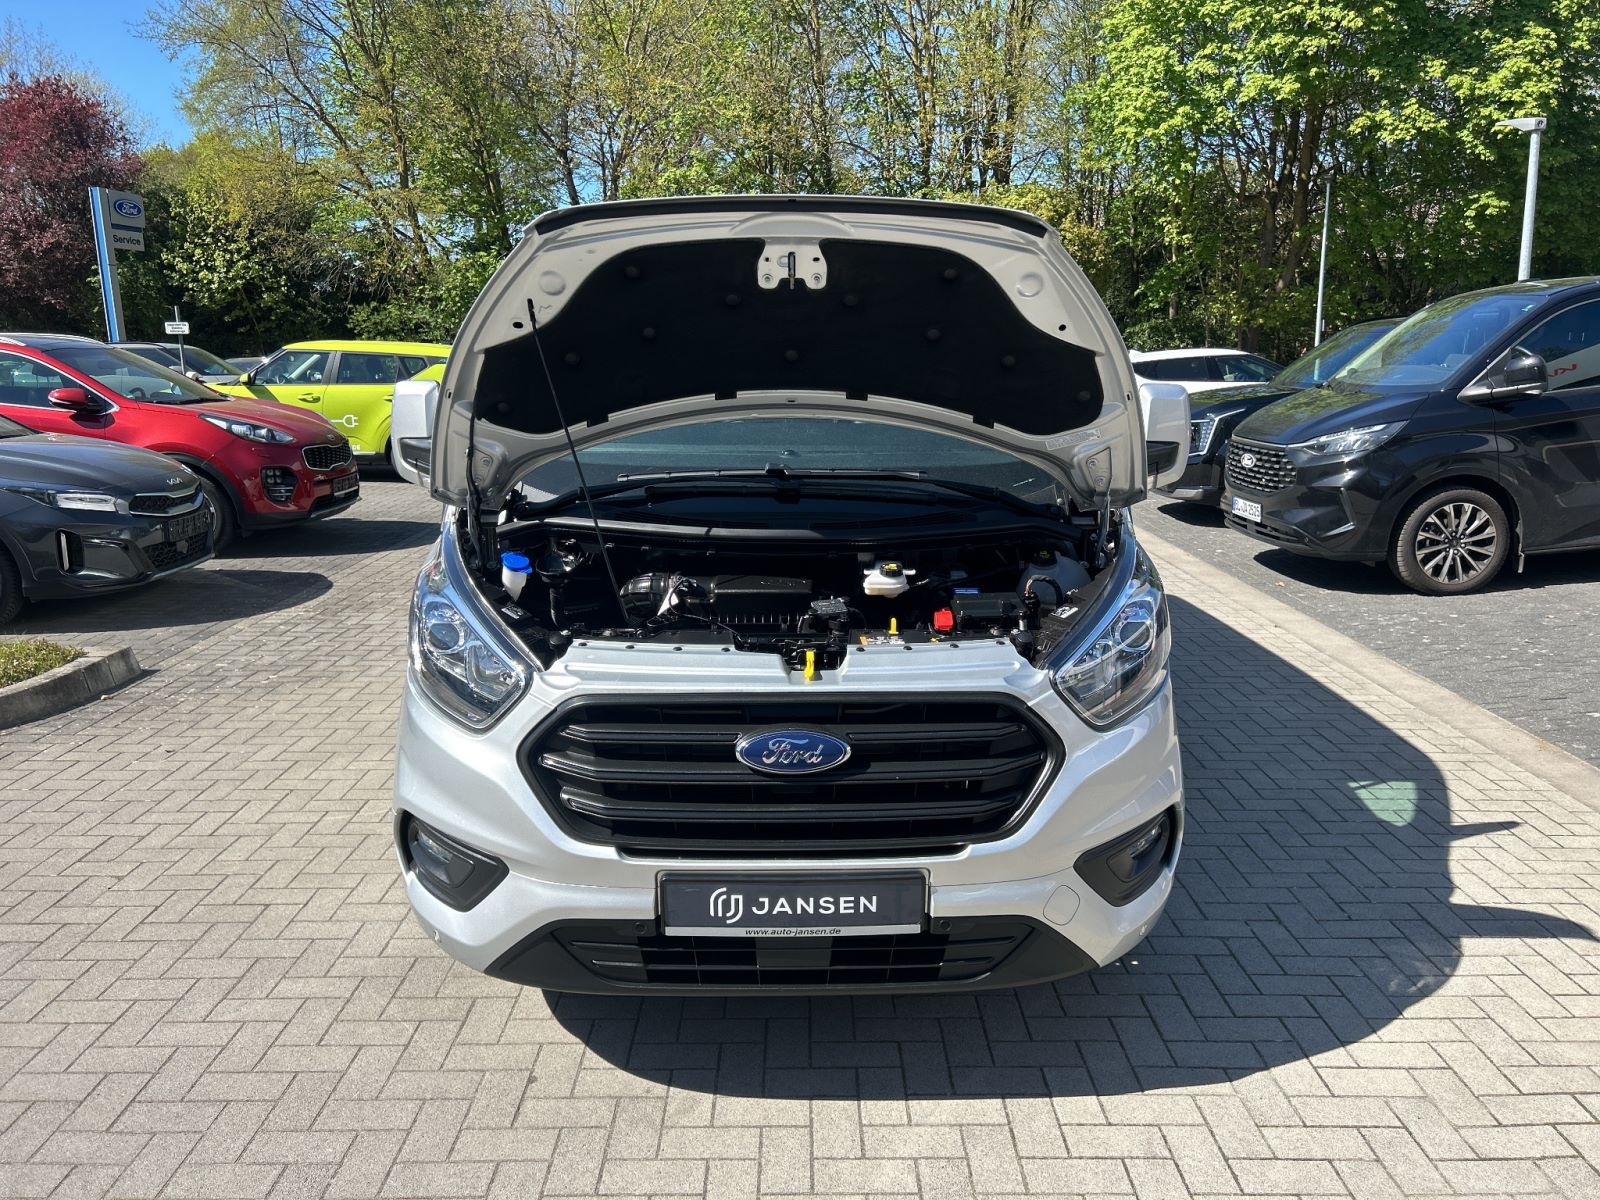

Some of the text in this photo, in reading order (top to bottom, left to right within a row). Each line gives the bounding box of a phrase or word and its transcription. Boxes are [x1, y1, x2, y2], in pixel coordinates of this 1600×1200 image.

[121, 202, 138, 214] Ford
[113, 234, 141, 246] Service
[761, 738, 823, 765] Ford
[752, 895, 877, 915] JANSEN
[745, 927, 841, 937] www.auto-jansen.de
